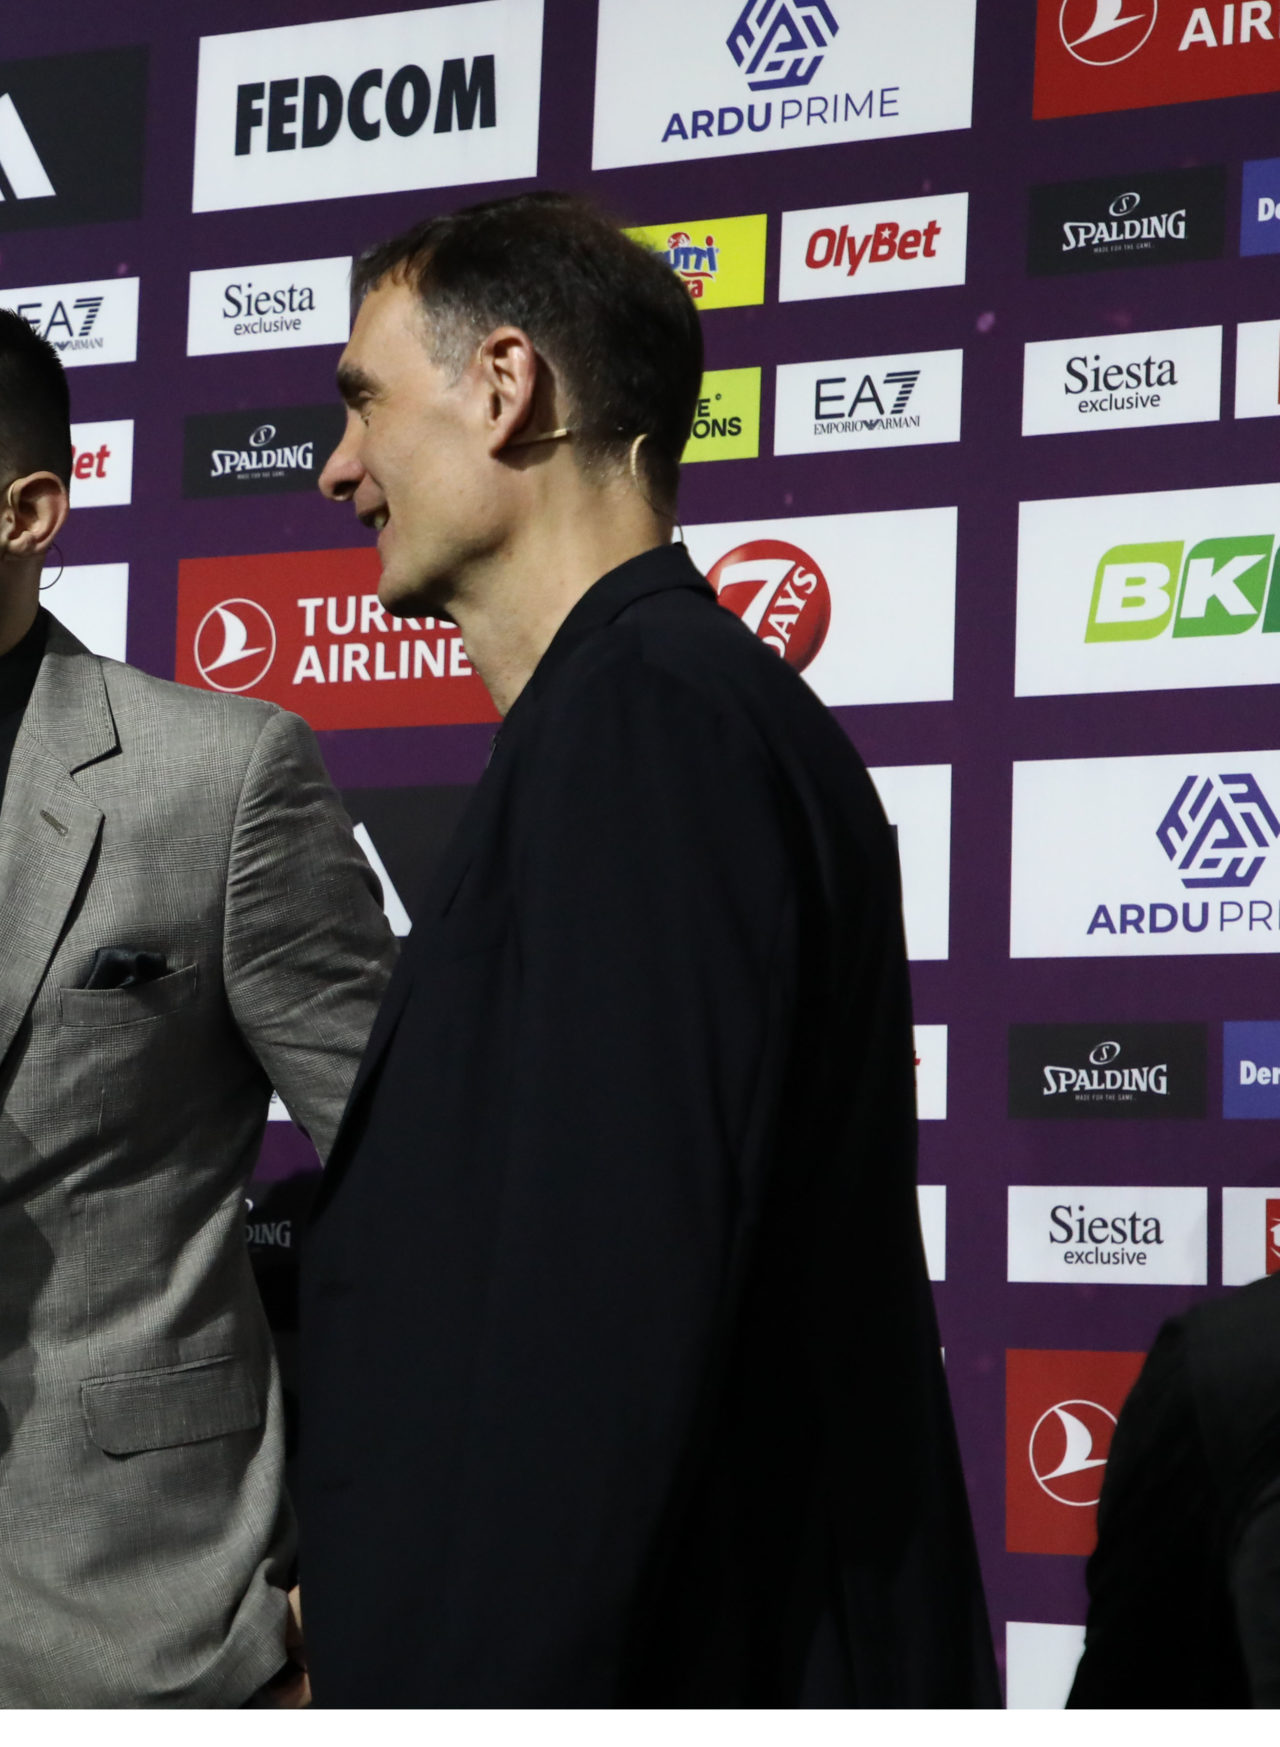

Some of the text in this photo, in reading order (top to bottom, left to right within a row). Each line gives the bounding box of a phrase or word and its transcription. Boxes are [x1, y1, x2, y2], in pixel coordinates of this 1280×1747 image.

[1177, 0, 1280, 52] AIR
[234, 54, 497, 157] FEDCOM
[805, 220, 942, 276] OlyBet
[1062, 208, 1186, 251] SPALDING
[222, 283, 315, 320] Siesta
[233, 316, 302, 336] exclusive
[815, 370, 921, 420] EA7
[1064, 354, 1178, 395] Siesta
[1078, 392, 1161, 413] exclusive
[814, 415, 920, 435] EMPORIO ARMANI
[210, 441, 313, 477] SPALDING
[717, 558, 797, 634] 7
[292, 637, 473, 685] AIRLINE
[1043, 1064, 1167, 1095] SPALDING
[1049, 1204, 1164, 1246] Siesta
[1063, 1248, 1147, 1266] exclusive
